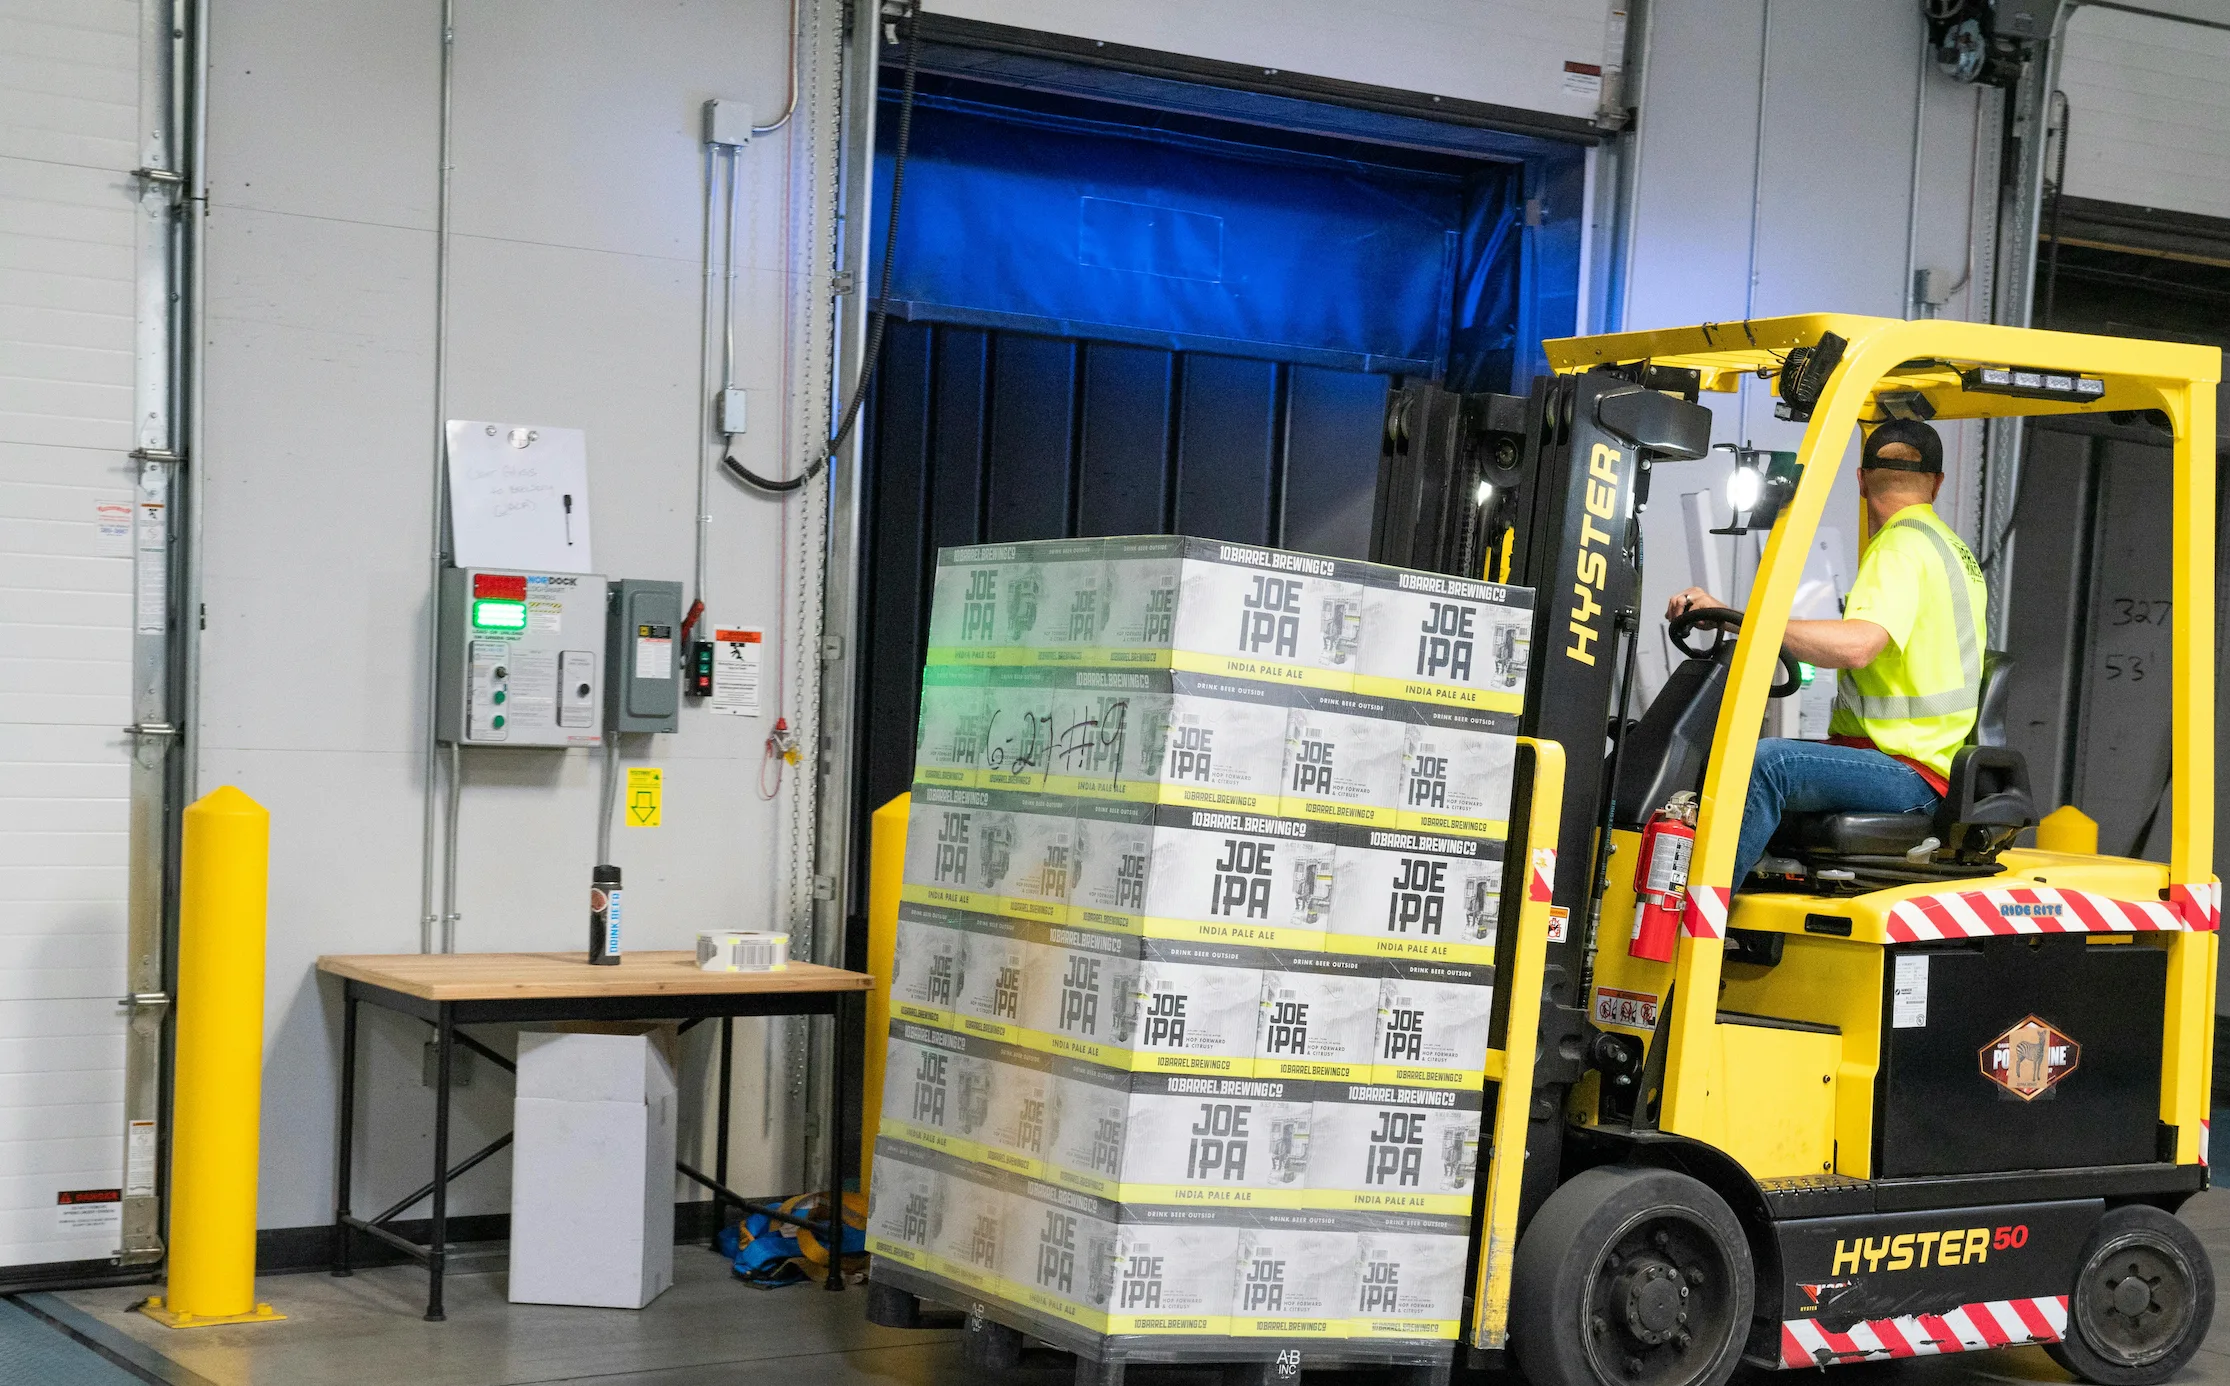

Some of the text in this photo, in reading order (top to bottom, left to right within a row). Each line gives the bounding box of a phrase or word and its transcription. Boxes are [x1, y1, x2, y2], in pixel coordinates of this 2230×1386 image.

[1566, 442, 1621, 667] HYSTER
[528, 576, 577, 586] NORDOCK
[966, 570, 998, 600] JOE
[1244, 575, 1303, 614] JOE
[1071, 590, 1096, 612] JOE
[1146, 590, 1174, 612] JOE
[2113, 598, 2172, 626] 327
[962, 603, 995, 641] IPA
[1068, 614, 1095, 641] IPA
[1143, 614, 1171, 642] IPA
[1239, 610, 1300, 658] IPA
[1422, 602, 1476, 639] JOE
[1228, 662, 1303, 678] INDIA PALE ALE
[1417, 636, 1473, 681] IPA
[1197, 683, 1217, 691] DRINK
[1238, 688, 1265, 696] OUTSIDE
[1406, 686, 1476, 701] INDIA PALE ALE
[1320, 698, 1384, 711] DRINK BEER OUTSIDE
[1173, 727, 1213, 752] JOE
[1296, 740, 1335, 765] JOE
[1170, 750, 1211, 782] IPA
[1293, 764, 1332, 795] IPA
[1411, 755, 1448, 779] JOE
[1408, 779, 1446, 808] IPA
[938, 812, 971, 843] JOE
[934, 844, 968, 884] IPA
[1118, 855, 1145, 878] JOE
[1216, 840, 1275, 876] JOE
[1393, 859, 1447, 893] JOE
[1115, 878, 1142, 909] IPA
[1211, 874, 1271, 919] IPA
[1388, 892, 1444, 935] IPA
[2000, 902, 2062, 917] RIDE RITE
[1200, 926, 1275, 939] INDIA PALE ALE
[1377, 942, 1447, 955] INDIA PALE ALE
[1063, 955, 1101, 992] JOE
[1059, 989, 1098, 1035] IPA
[1147, 994, 1187, 1017] JOE
[1270, 1002, 1309, 1025] JOE
[1144, 1018, 1185, 1047] IPA
[1387, 1009, 1424, 1032] JOE
[1052, 1040, 1099, 1056] INDIA PALE ALE
[1267, 1026, 1306, 1054] IPA
[1384, 1032, 1421, 1060] IPA
[916, 1050, 948, 1086] JOE
[913, 1082, 945, 1126] IPA
[1192, 1104, 1251, 1137] JOE
[1371, 1112, 1426, 1144] JOE
[1187, 1138, 1248, 1180] IPA
[1366, 1145, 1422, 1186] IPA
[1175, 1190, 1203, 1199] INDIA
[1208, 1191, 1230, 1200] PALE
[1355, 1195, 1424, 1206] INDIA PALE ALE
[1040, 1210, 1076, 1250] JOE
[1831, 1224, 2029, 1276] HYSTER 50
[1036, 1244, 1075, 1294] IPA
[1124, 1256, 1164, 1279] JOE
[1247, 1260, 1286, 1282] JOE
[1363, 1262, 1400, 1284] JOE
[1120, 1280, 1161, 1308] IPA
[1243, 1284, 1283, 1311] IPA
[1359, 1285, 1398, 1313] IPA
[1278, 1364, 1297, 1375] INC
